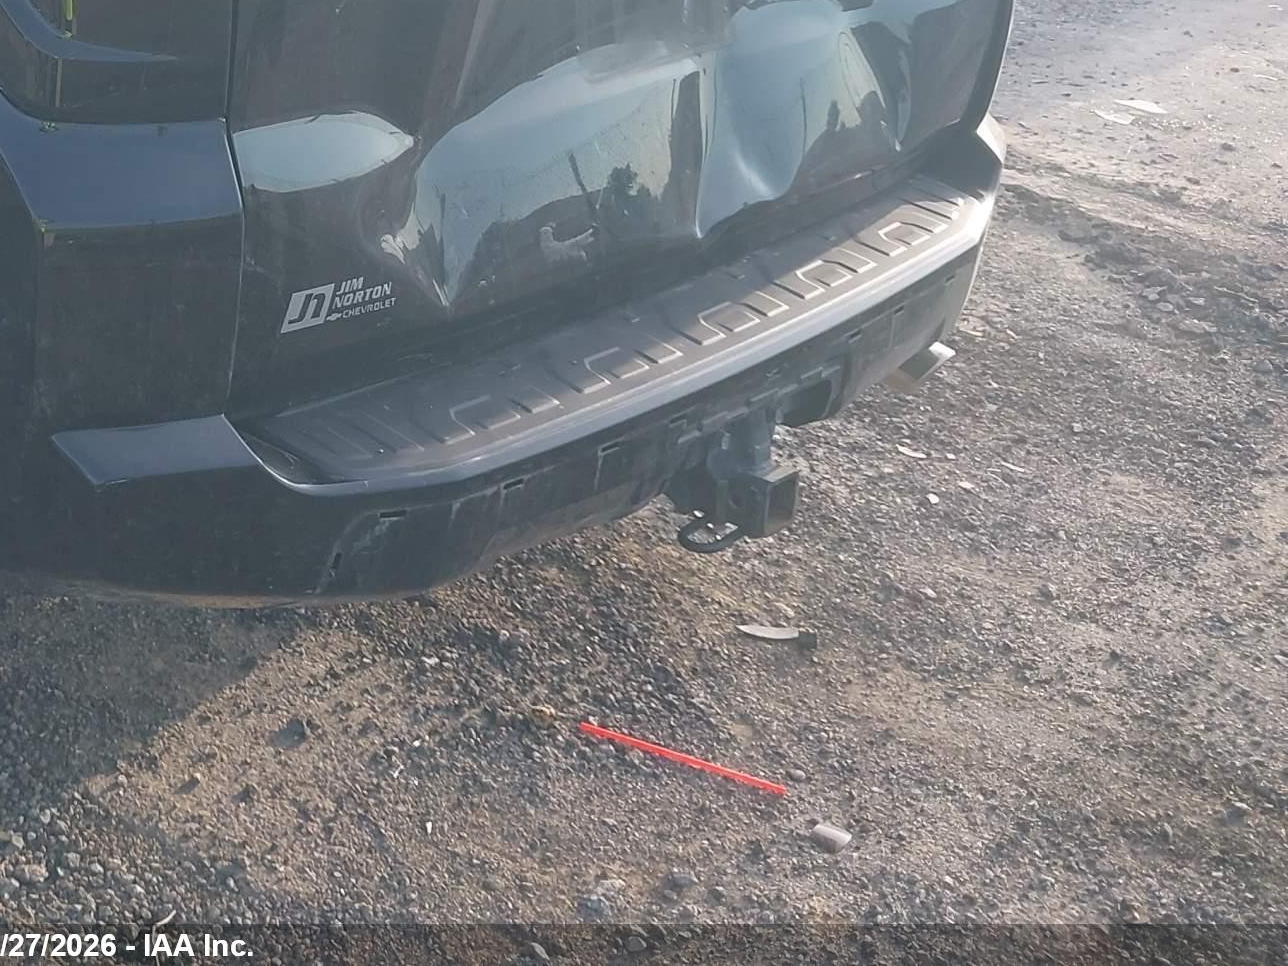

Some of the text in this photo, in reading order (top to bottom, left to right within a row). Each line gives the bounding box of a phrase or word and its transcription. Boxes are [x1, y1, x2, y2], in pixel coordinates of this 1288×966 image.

[332, 281, 393, 310] NORTON
[336, 276, 364, 296] JIM
[342, 297, 397, 319] CHEVROLET
